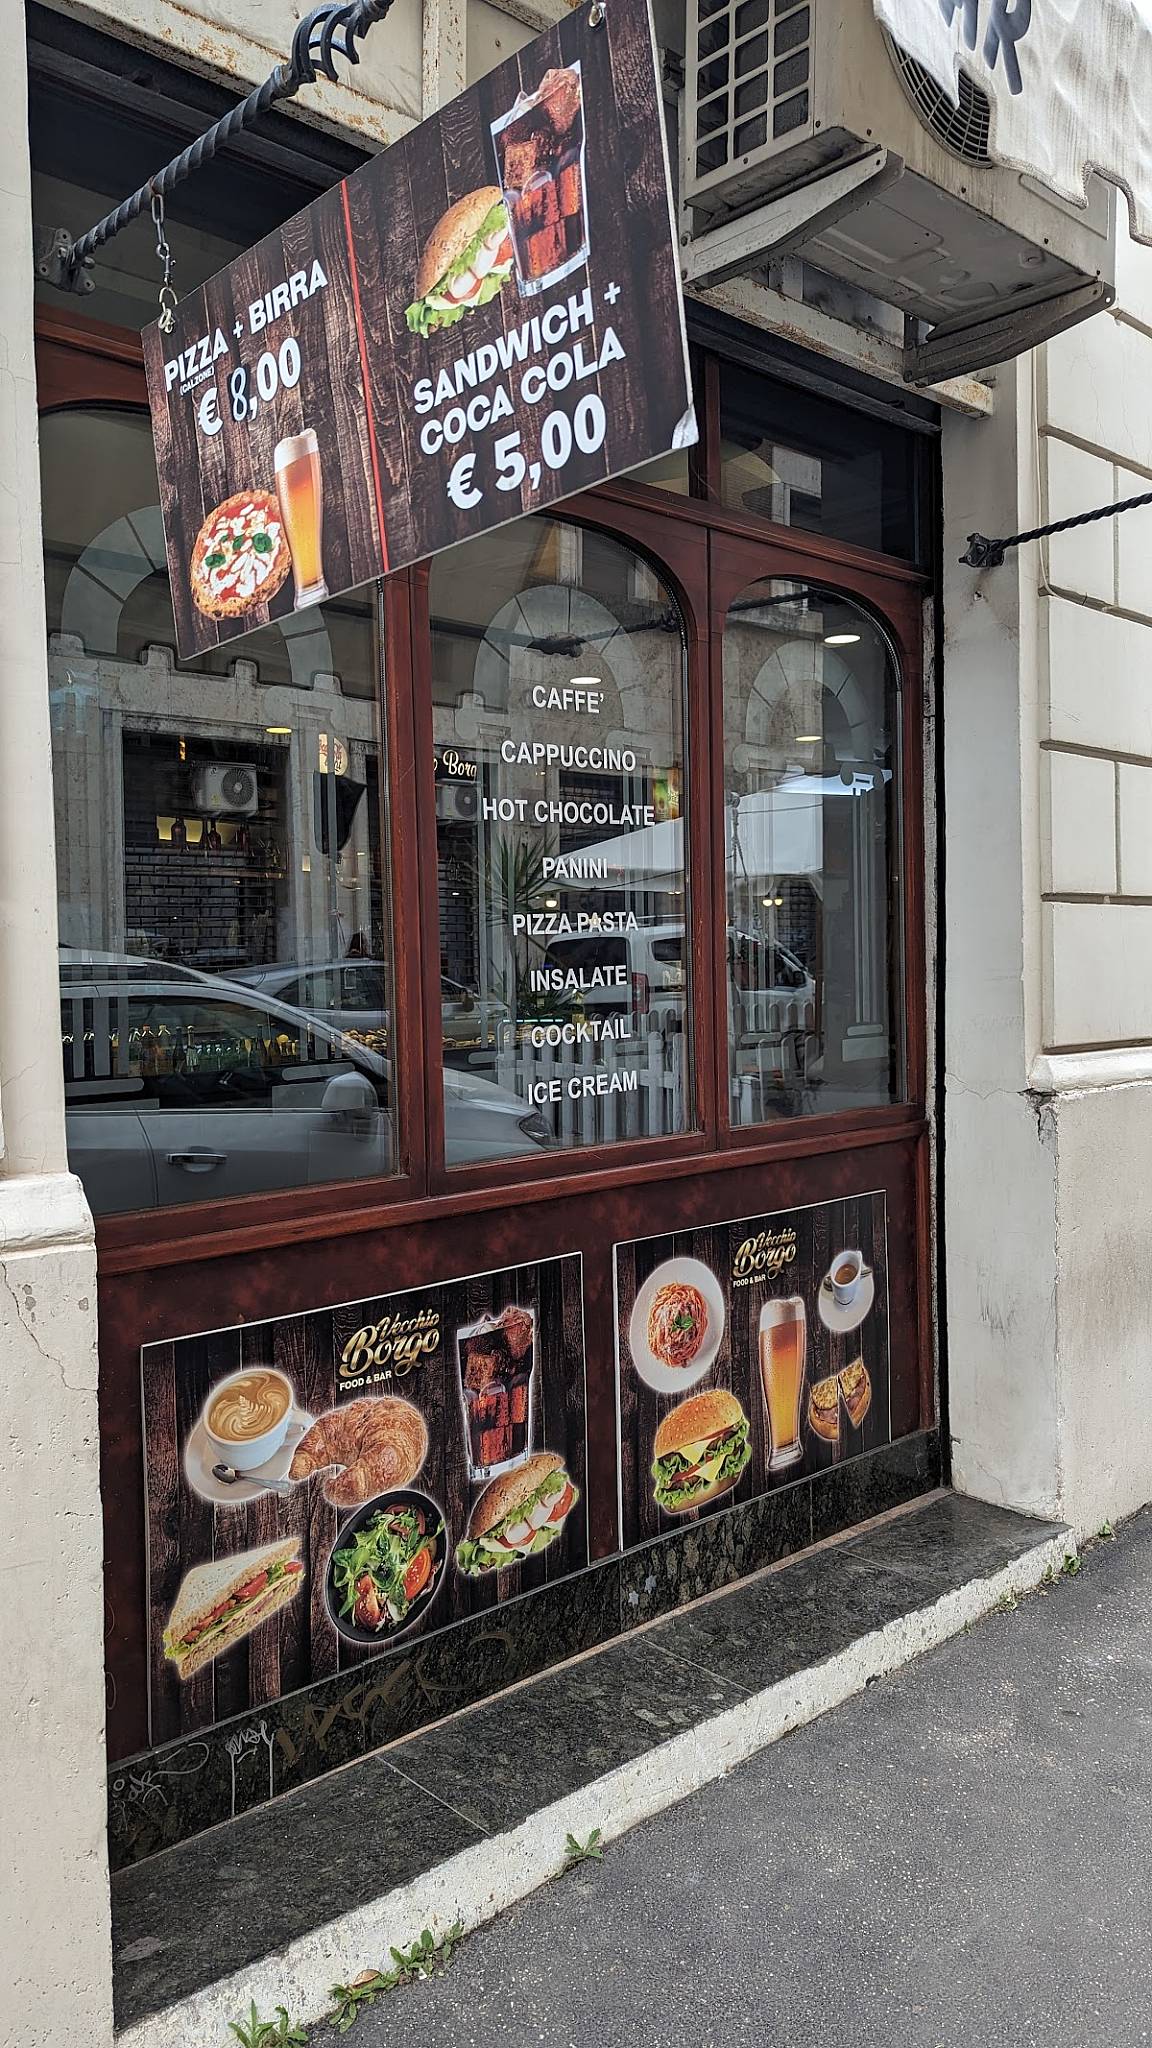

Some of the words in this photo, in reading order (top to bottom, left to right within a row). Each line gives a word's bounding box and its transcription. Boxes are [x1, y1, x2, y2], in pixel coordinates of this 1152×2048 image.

[164, 328, 229, 392] PIZZA
[249, 259, 328, 335] BIRRA
[414, 287, 594, 414] SANDWICH
[180, 366, 215, 396] (CALZONE)
[198, 387, 223, 436] €
[230, 337, 301, 421] 8,00
[420, 384, 514, 454] COCA
[520, 327, 626, 404] COLA
[447, 453, 483, 509] €
[494, 393, 606, 491] 5,00
[500, 740, 636, 771] CAPPUCCINO
[482, 797, 528, 821] HOT
[534, 800, 655, 826] CHOCOLATE
[542, 857, 608, 880] PANINI
[513, 914, 572, 936] PIZZA
[577, 911, 638, 934] PASTA
[530, 965, 627, 992] INSALATE
[531, 1017, 631, 1048] COCKTAIL
[528, 1081, 562, 1105] ICE
[567, 1070, 638, 1100] CREAM
[756, 1228, 796, 1251] Vecchio
[733, 1238, 796, 1280] Borgo
[733, 1278, 749, 1288] FOOD
[754, 1274, 766, 1283] BAR
[376, 1309, 440, 1341] Vecchio
[339, 1325, 440, 1377] Borgo
[339, 1378, 364, 1391] FOOD
[366, 1376, 372, 1384] &
[373, 1370, 392, 1382] BAR
